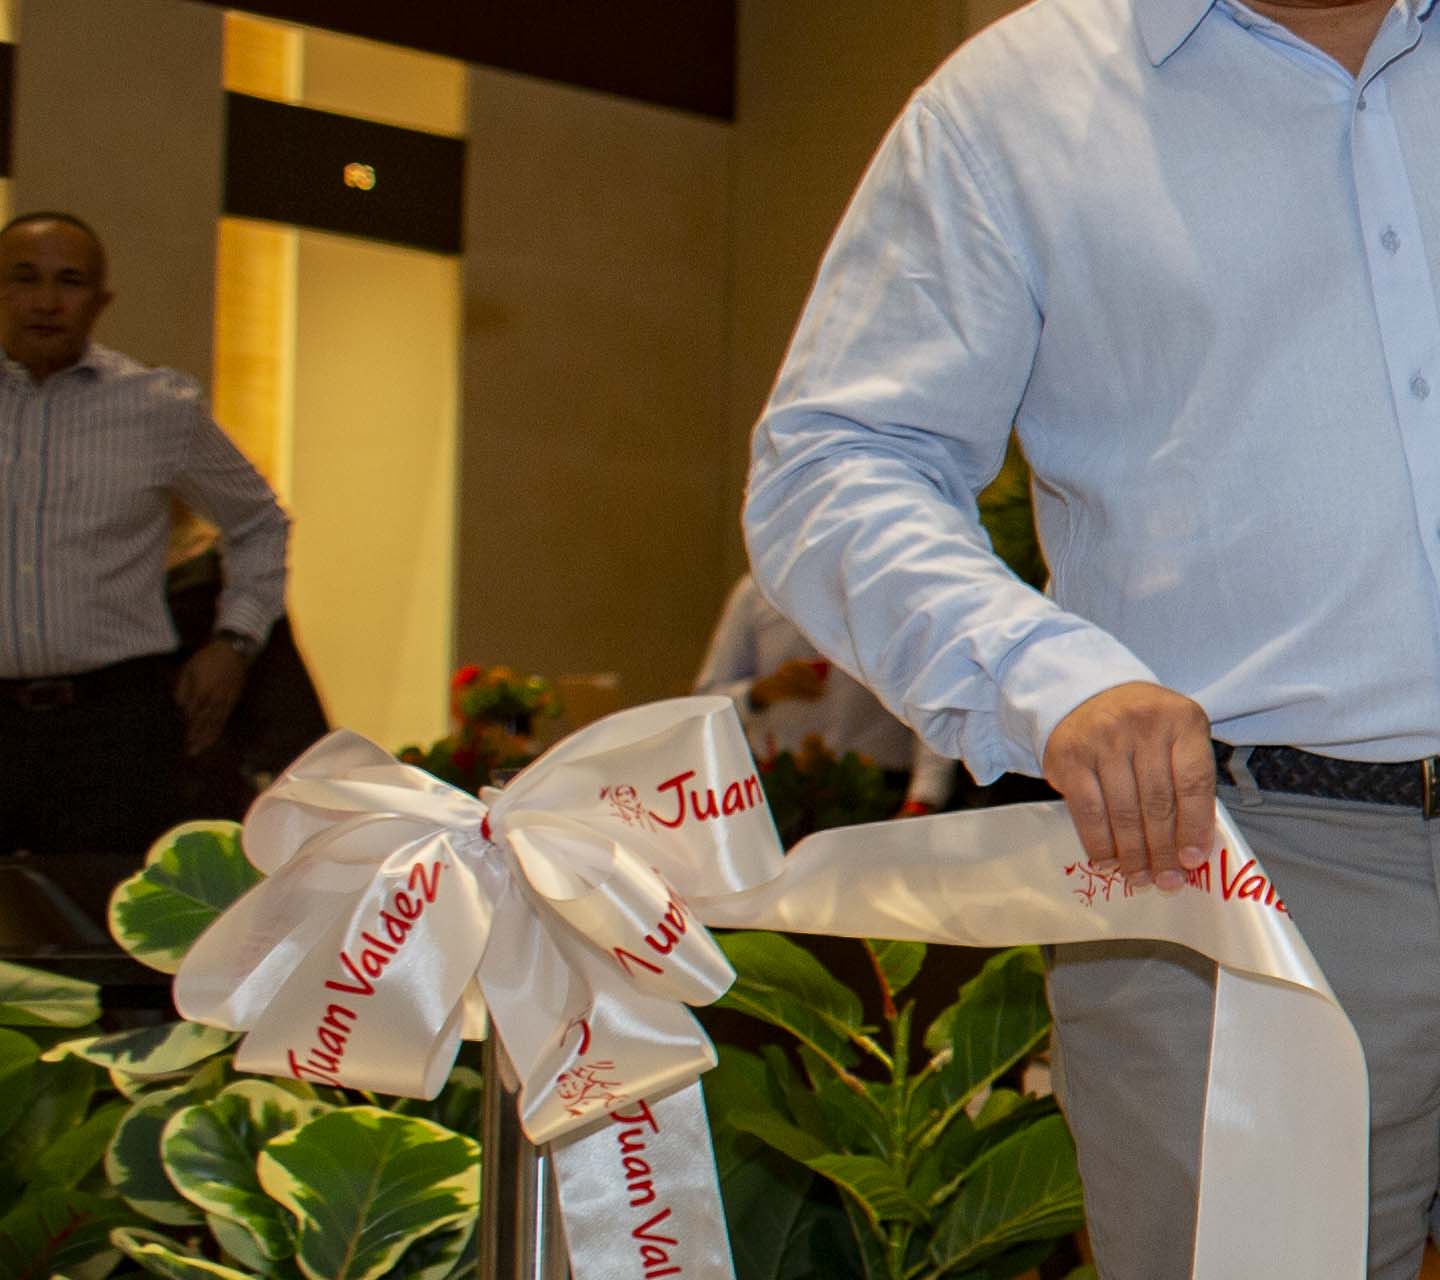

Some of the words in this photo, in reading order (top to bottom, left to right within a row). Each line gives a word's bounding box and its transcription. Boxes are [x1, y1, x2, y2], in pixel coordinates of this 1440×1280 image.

[651, 770, 762, 829] Juan
[288, 997, 358, 1087] Juan
[326, 861, 442, 999] Valdez
[611, 1098, 659, 1208] Juan
